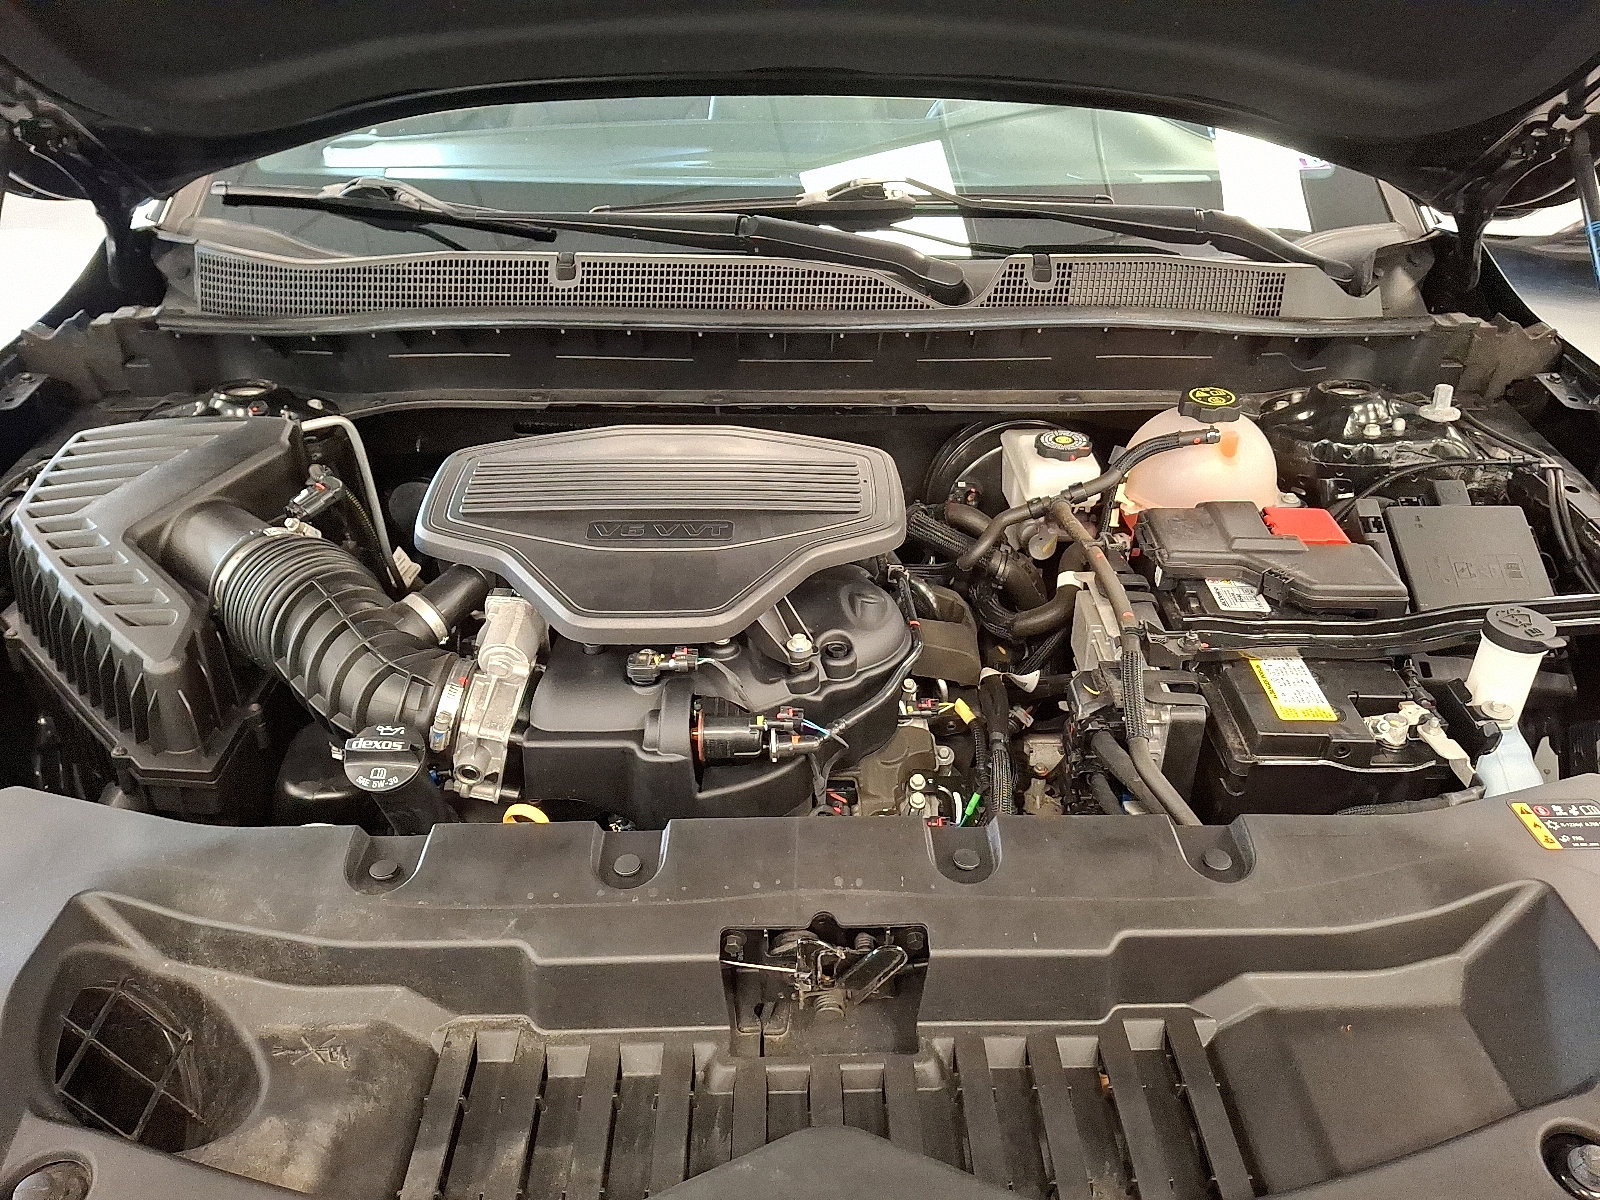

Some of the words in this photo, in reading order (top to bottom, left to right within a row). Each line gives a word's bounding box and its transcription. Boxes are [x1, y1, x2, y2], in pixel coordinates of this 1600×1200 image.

[594, 523, 645, 537] V6
[653, 523, 729, 537] VVT
[351, 738, 405, 750] dexos
[356, 775, 371, 787] SAE
[372, 776, 399, 788] 5W-30
